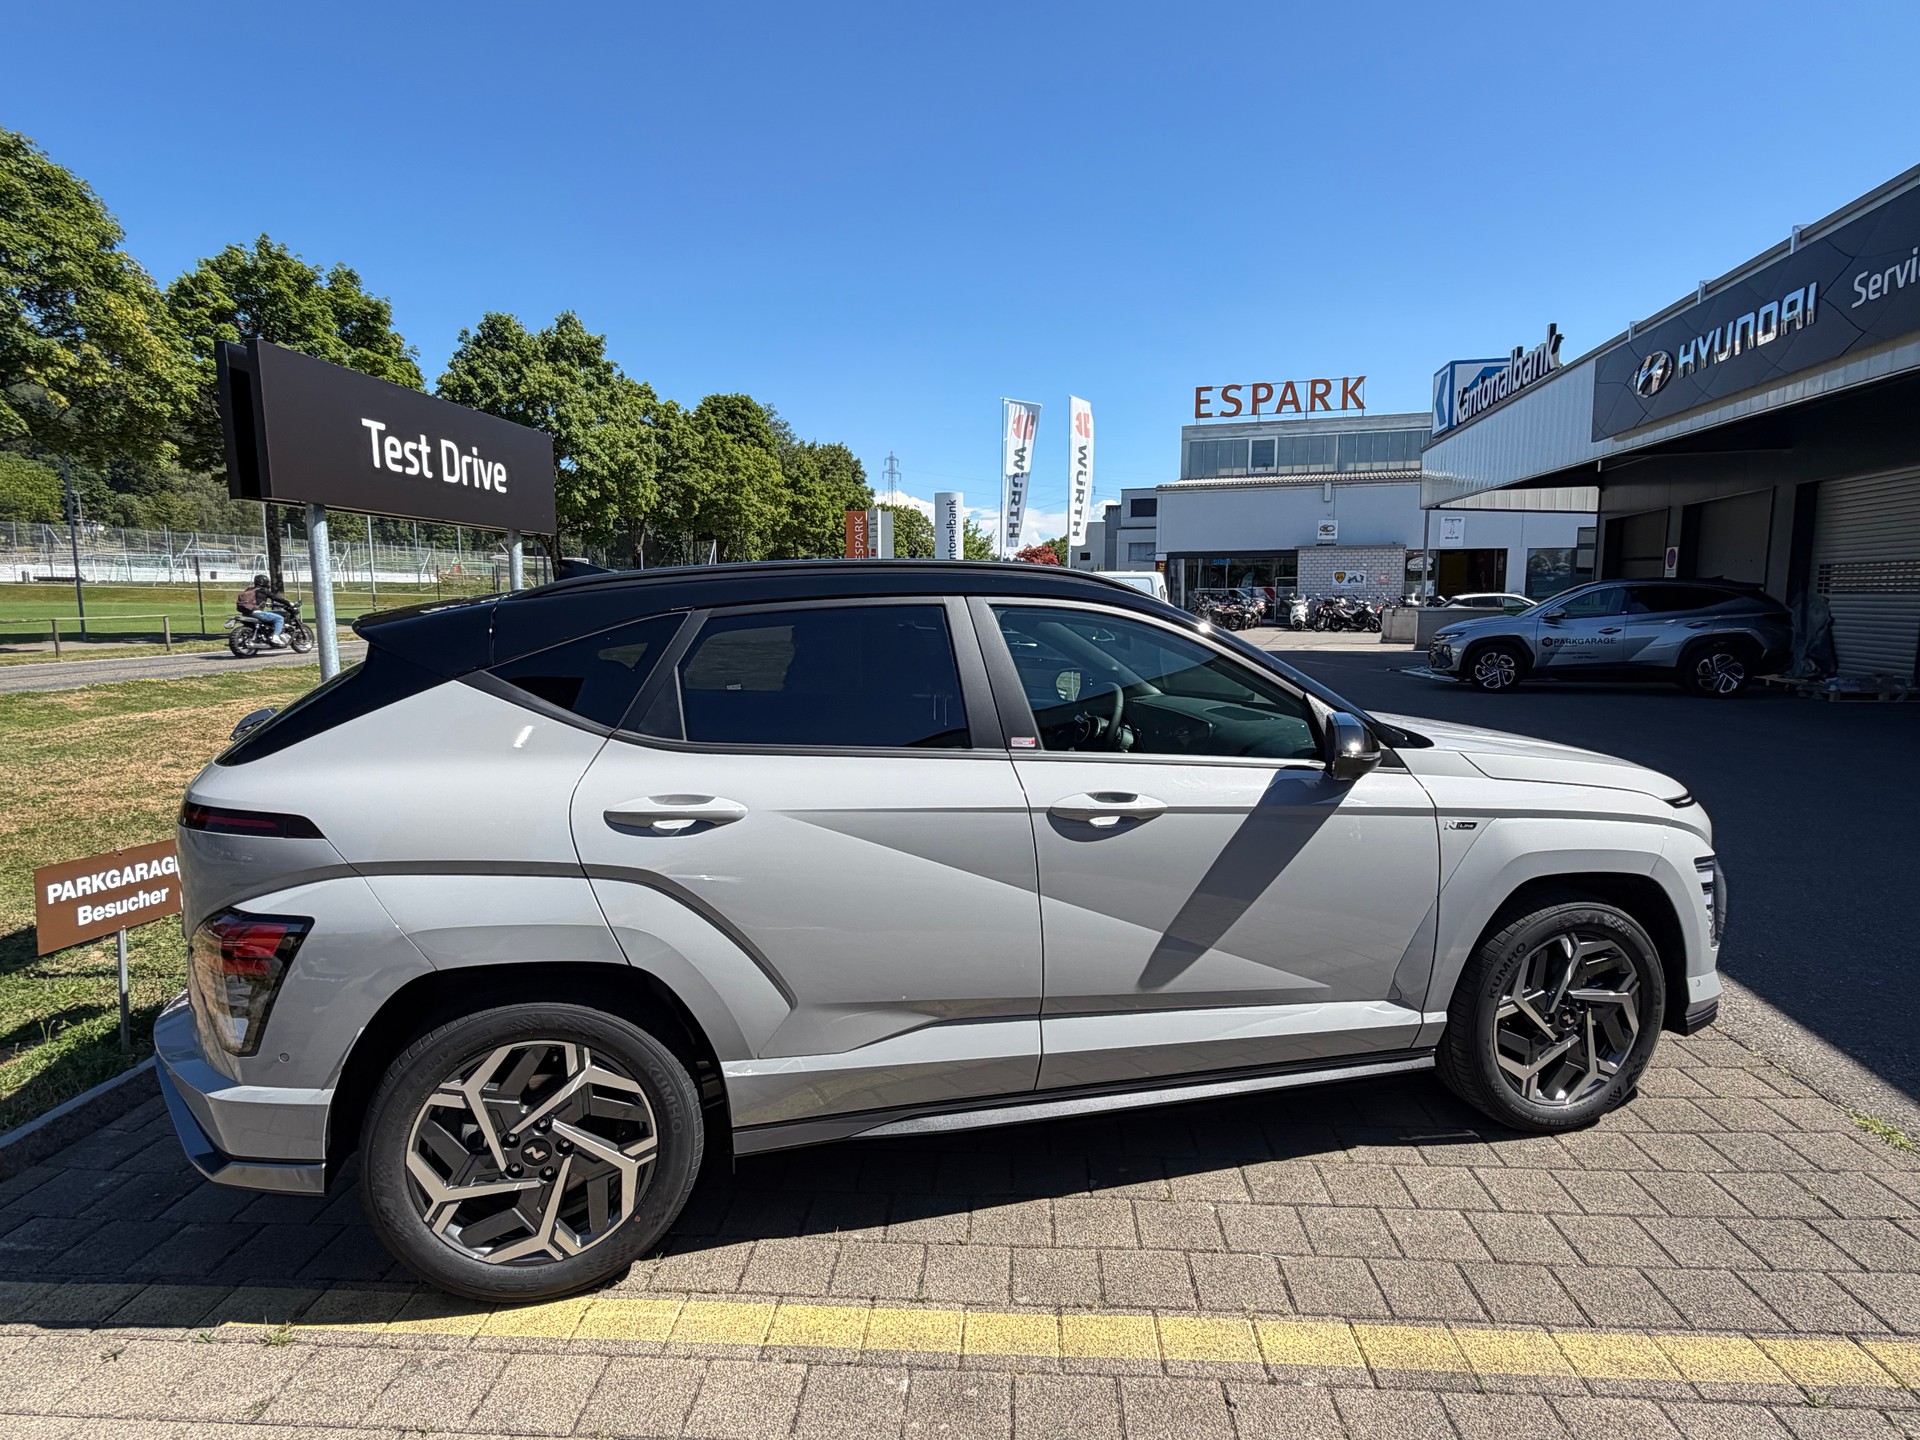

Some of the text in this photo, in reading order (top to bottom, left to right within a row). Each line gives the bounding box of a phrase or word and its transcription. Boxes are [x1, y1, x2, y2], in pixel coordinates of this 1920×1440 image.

[1851, 246, 1920, 309] Servi
[1677, 281, 1819, 379] HYUNDAI
[1195, 376, 1367, 418] ESPARK
[1453, 323, 1564, 426] Kantonalbank
[361, 418, 507, 494] Test Drive
[1072, 444, 1088, 537] WÜRTH
[1008, 446, 1028, 539] WÜRTH
[1553, 637, 1617, 646] PARKGARAGE
[77, 887, 169, 926] Besucher
[1488, 942, 1527, 999] KUMHO
[647, 1063, 682, 1134] KUMHO
